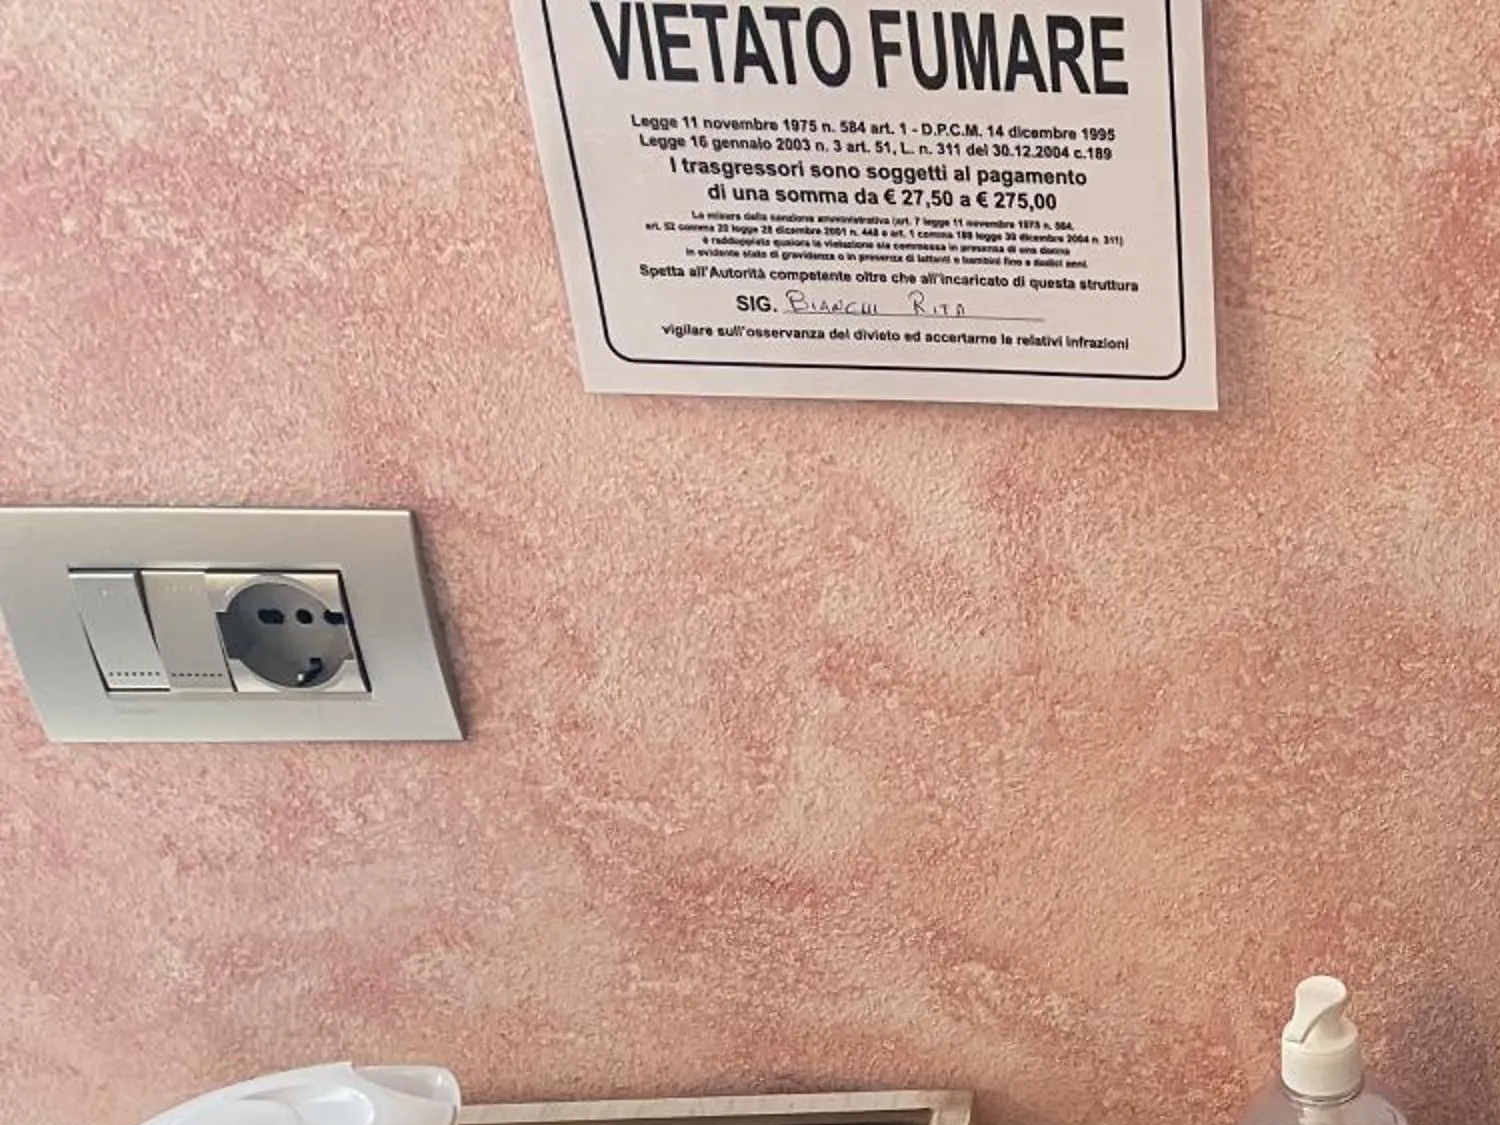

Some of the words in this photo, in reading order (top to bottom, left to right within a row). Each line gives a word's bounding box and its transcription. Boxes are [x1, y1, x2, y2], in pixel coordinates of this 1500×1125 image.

[590, 2, 850, 87] VIETATO
[869, 9, 1129, 95] FUMARE
[630, 113, 678, 130] Legge
[682, 115, 698, 129] 11
[702, 118, 779, 132] novembre
[782, 118, 818, 133] 1975
[820, 121, 836, 133] n.
[838, 119, 866, 134] 584
[868, 121, 894, 135] art.
[898, 121, 907, 135] 1
[986, 123, 1004, 138] 14
[1006, 124, 1077, 140] dicembre
[638, 135, 687, 151] Legge
[710, 137, 773, 153] gennaio
[775, 138, 812, 152] 2003
[814, 140, 830, 153] n.
[832, 139, 843, 153] 3
[844, 139, 870, 154] art.
[899, 141, 914, 155] L.
[917, 144, 932, 155] n.
[935, 142, 961, 157] 311
[964, 142, 990, 157] del
[669, 155, 677, 173] I
[680, 158, 805, 180] trasgressori
[808, 163, 861, 179] sono
[864, 162, 948, 185] soggetti
[952, 163, 972, 183] al
[975, 167, 1087, 189] pagamento
[706, 182, 727, 201] di
[731, 186, 770, 202] una
[774, 188, 849, 204] somma
[852, 186, 879, 205] da
[882, 187, 897, 205] €
[900, 187, 954, 208] 27,50
[958, 193, 972, 208] a
[974, 189, 989, 209] €
[992, 190, 1057, 211] 275,00
[638, 263, 685, 278] Spetta
[768, 268, 853, 283] competente
[854, 269, 888, 283] oltre
[890, 271, 917, 285] che
[1011, 274, 1026, 288] di
[1028, 277, 1076, 292] questa
[1078, 278, 1139, 292] struttura
[736, 294, 778, 313] SIG.
[660, 322, 714, 339] vigilare
[716, 324, 826, 340] sull'osservanza
[828, 326, 851, 341] del
[852, 328, 901, 342] divieto
[902, 329, 922, 343] ed
[1000, 332, 1013, 346] le
[1015, 333, 1063, 347] relativi
[1064, 335, 1129, 350] infrazioni
